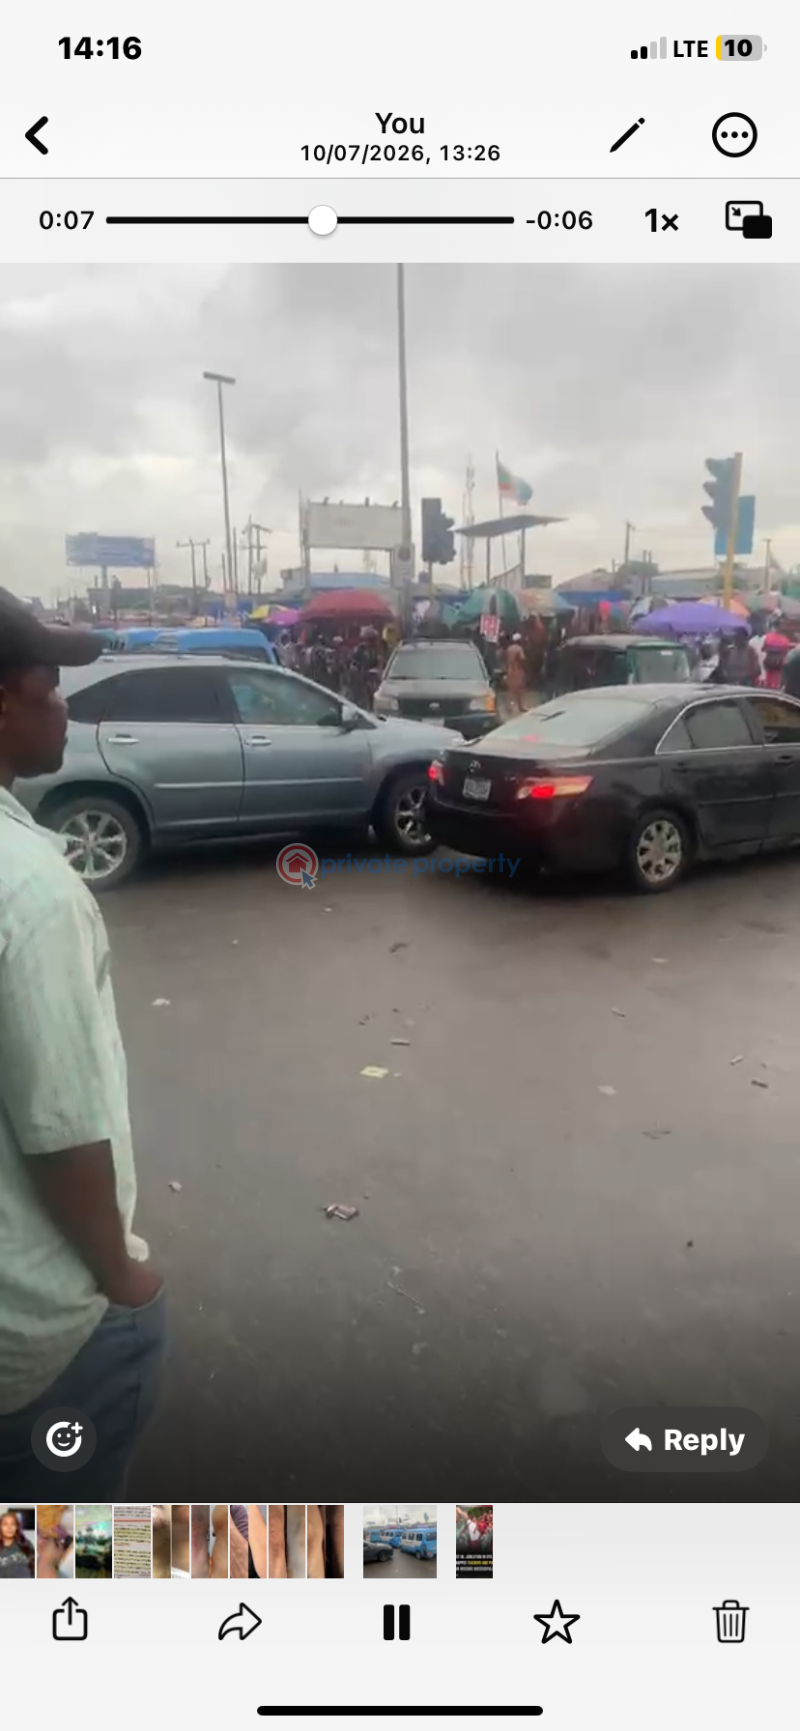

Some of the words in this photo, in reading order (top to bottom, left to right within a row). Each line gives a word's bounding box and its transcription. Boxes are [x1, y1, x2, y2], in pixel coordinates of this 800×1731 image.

[58, 36, 142, 61] 14:16
[673, 40, 709, 58] LTE
[723, 39, 753, 58] 10
[374, 112, 425, 135] You
[301, 144, 431, 165] 10/07/2026,
[440, 144, 501, 162] 13:26
[39, 210, 95, 230] 0:07
[525, 210, 593, 230] -0:06
[664, 1427, 746, 1457] Reply
